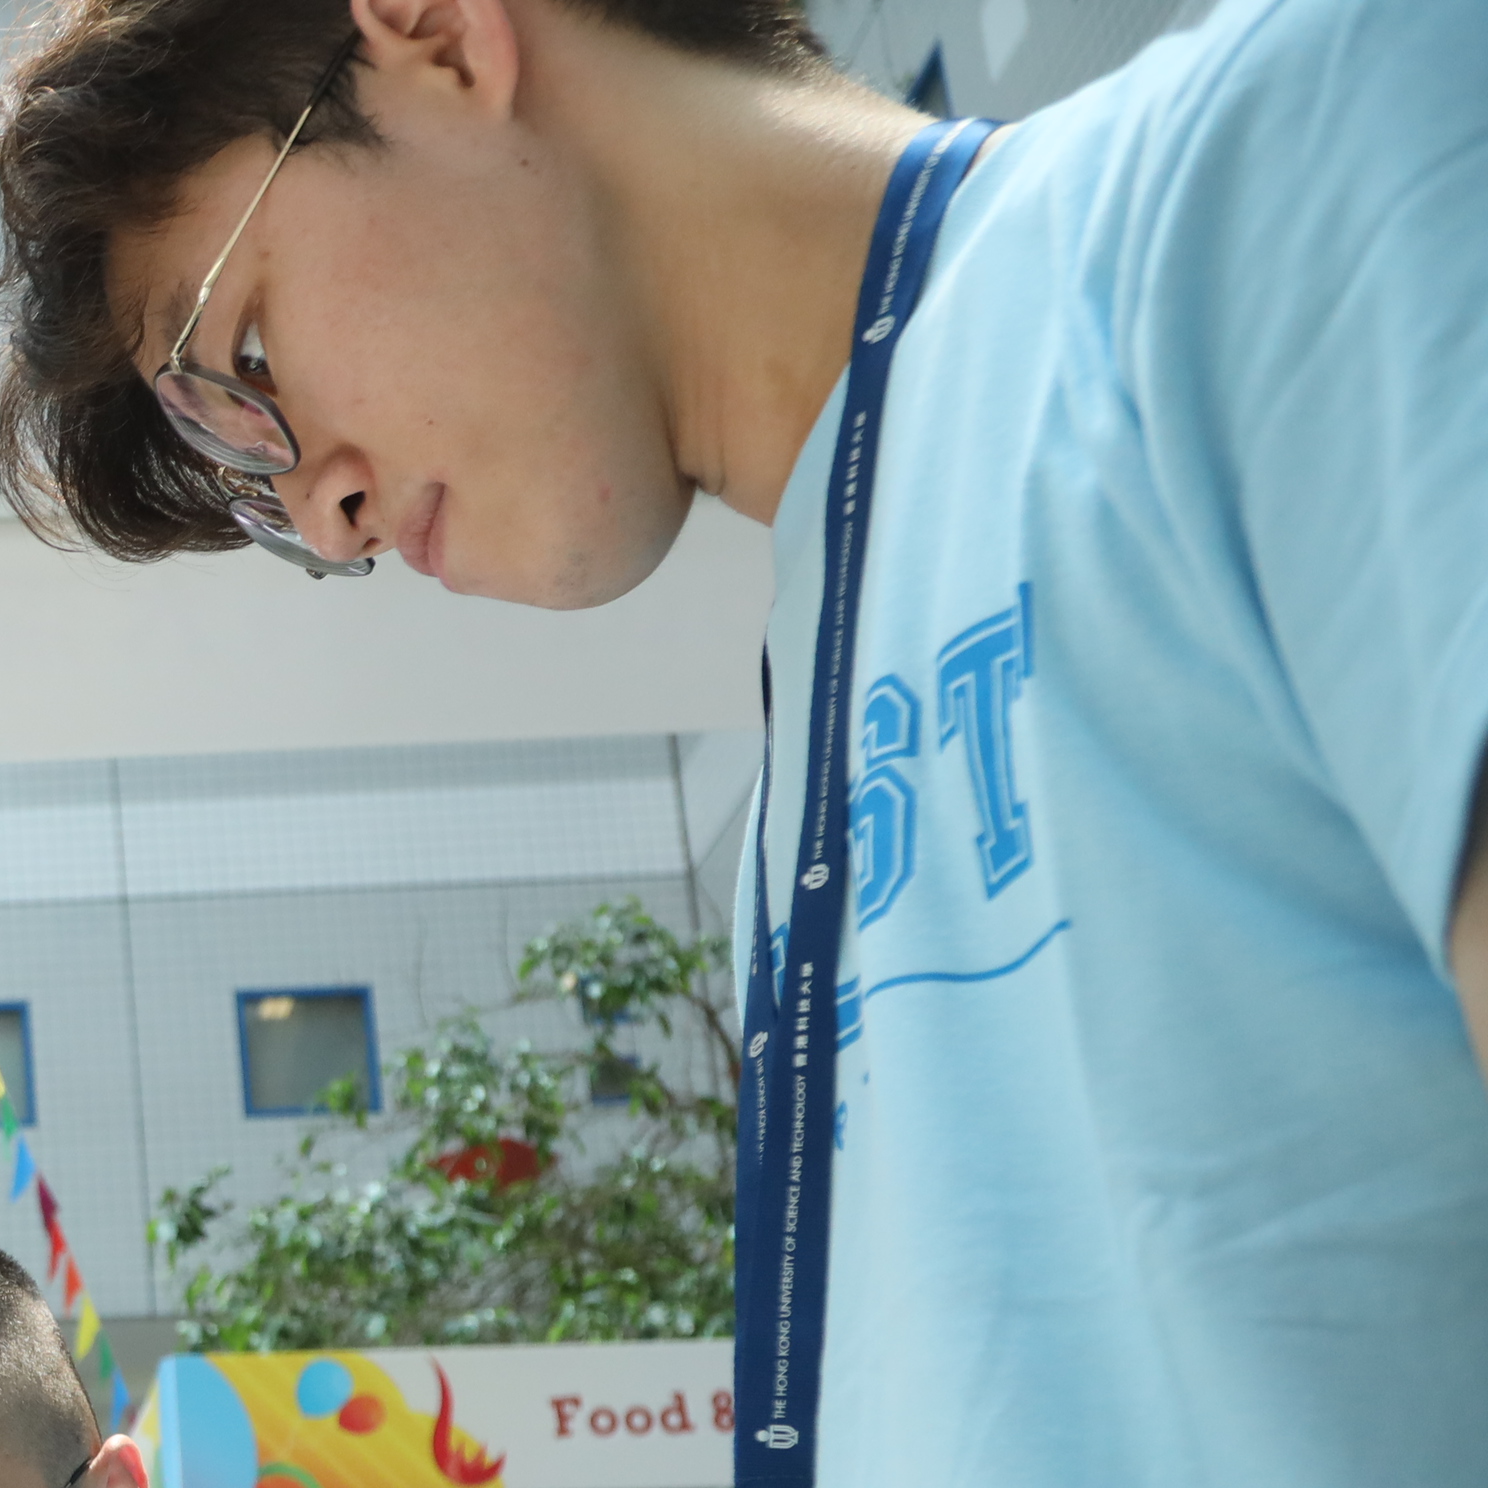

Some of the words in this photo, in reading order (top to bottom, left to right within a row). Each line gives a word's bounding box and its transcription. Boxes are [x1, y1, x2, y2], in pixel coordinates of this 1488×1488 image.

[791, 1075, 807, 1153] TECHNOLOGY
[789, 1156, 803, 1182] AND
[786, 1185, 801, 1233] SCIENCE
[783, 1235, 797, 1252] OF
[779, 1255, 796, 1319] UNIVERSITY
[777, 1320, 792, 1357] KONG
[775, 1359, 789, 1396] HONG
[550, 1390, 696, 1437] Food
[773, 1400, 787, 1420] THE
